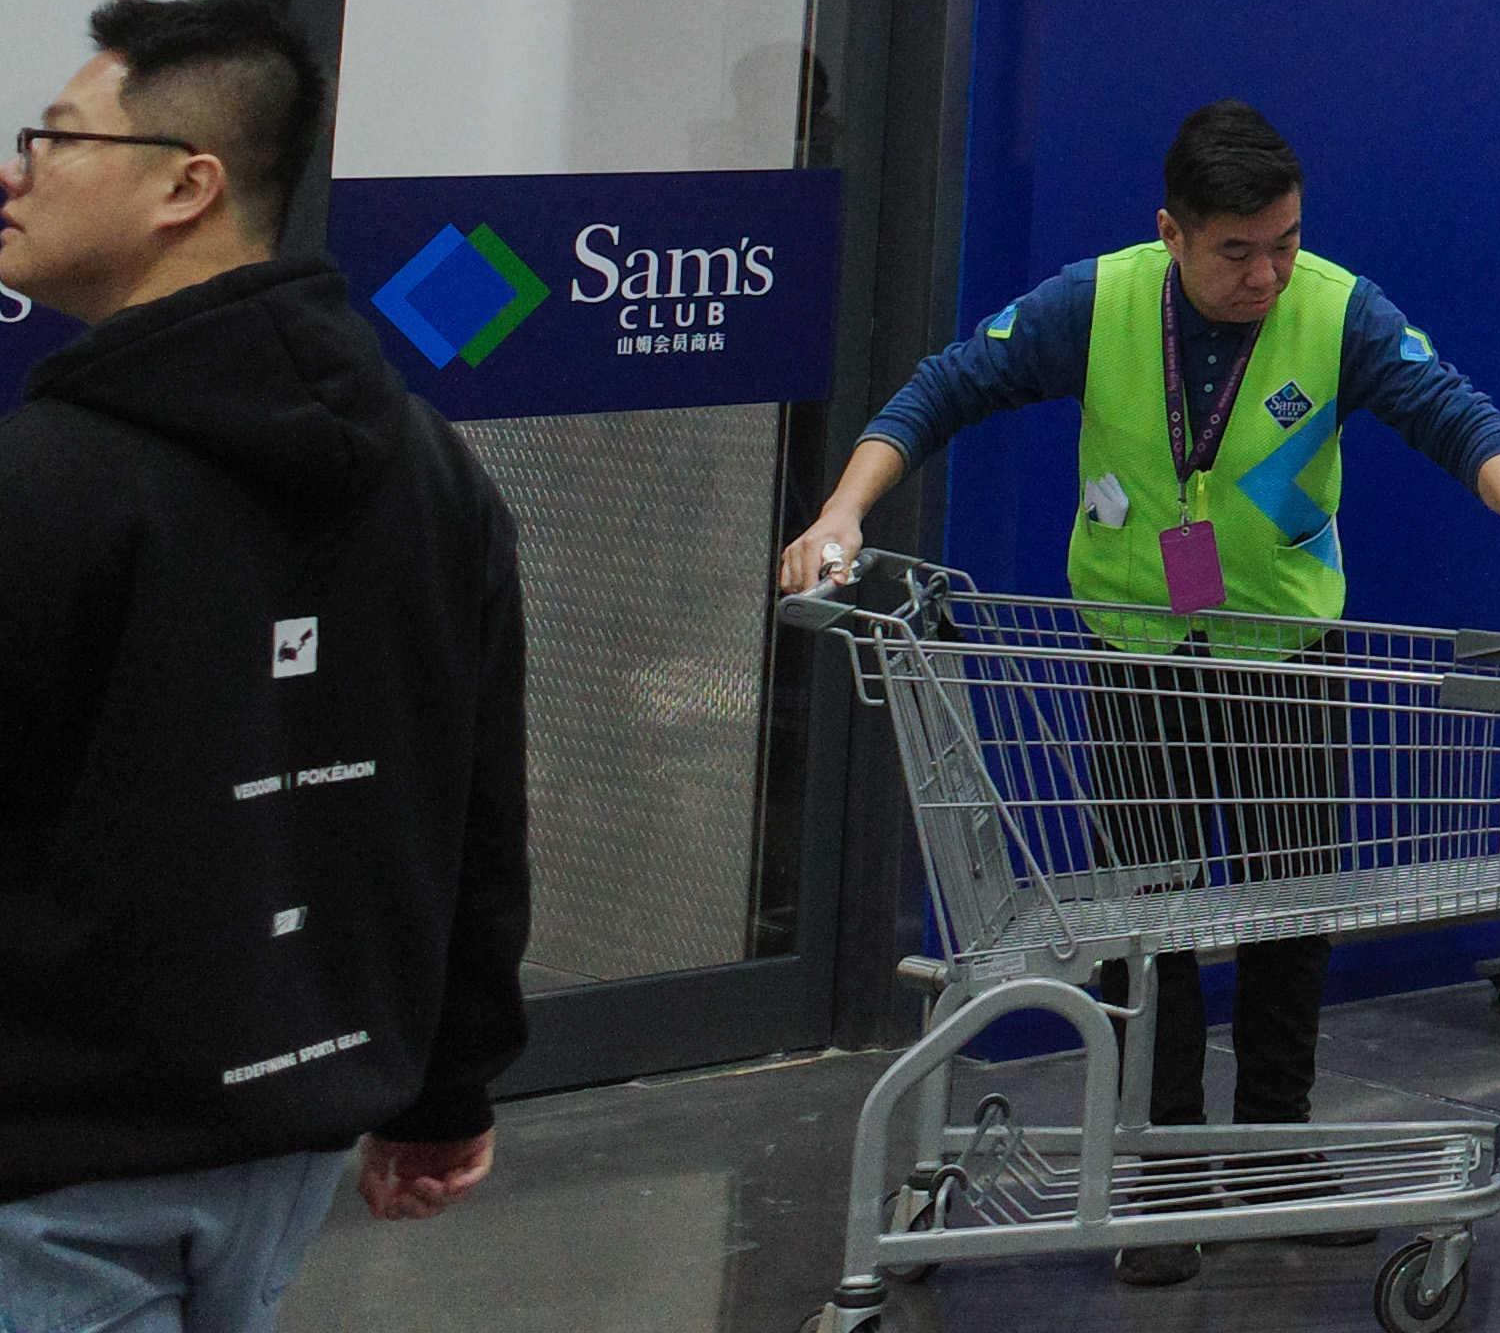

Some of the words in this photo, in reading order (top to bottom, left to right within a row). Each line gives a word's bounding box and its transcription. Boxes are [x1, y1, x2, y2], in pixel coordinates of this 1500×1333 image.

[571, 223, 774, 303] Sam's
[619, 301, 726, 329] CLUB
[617, 332, 727, 356] 山姆会员商店
